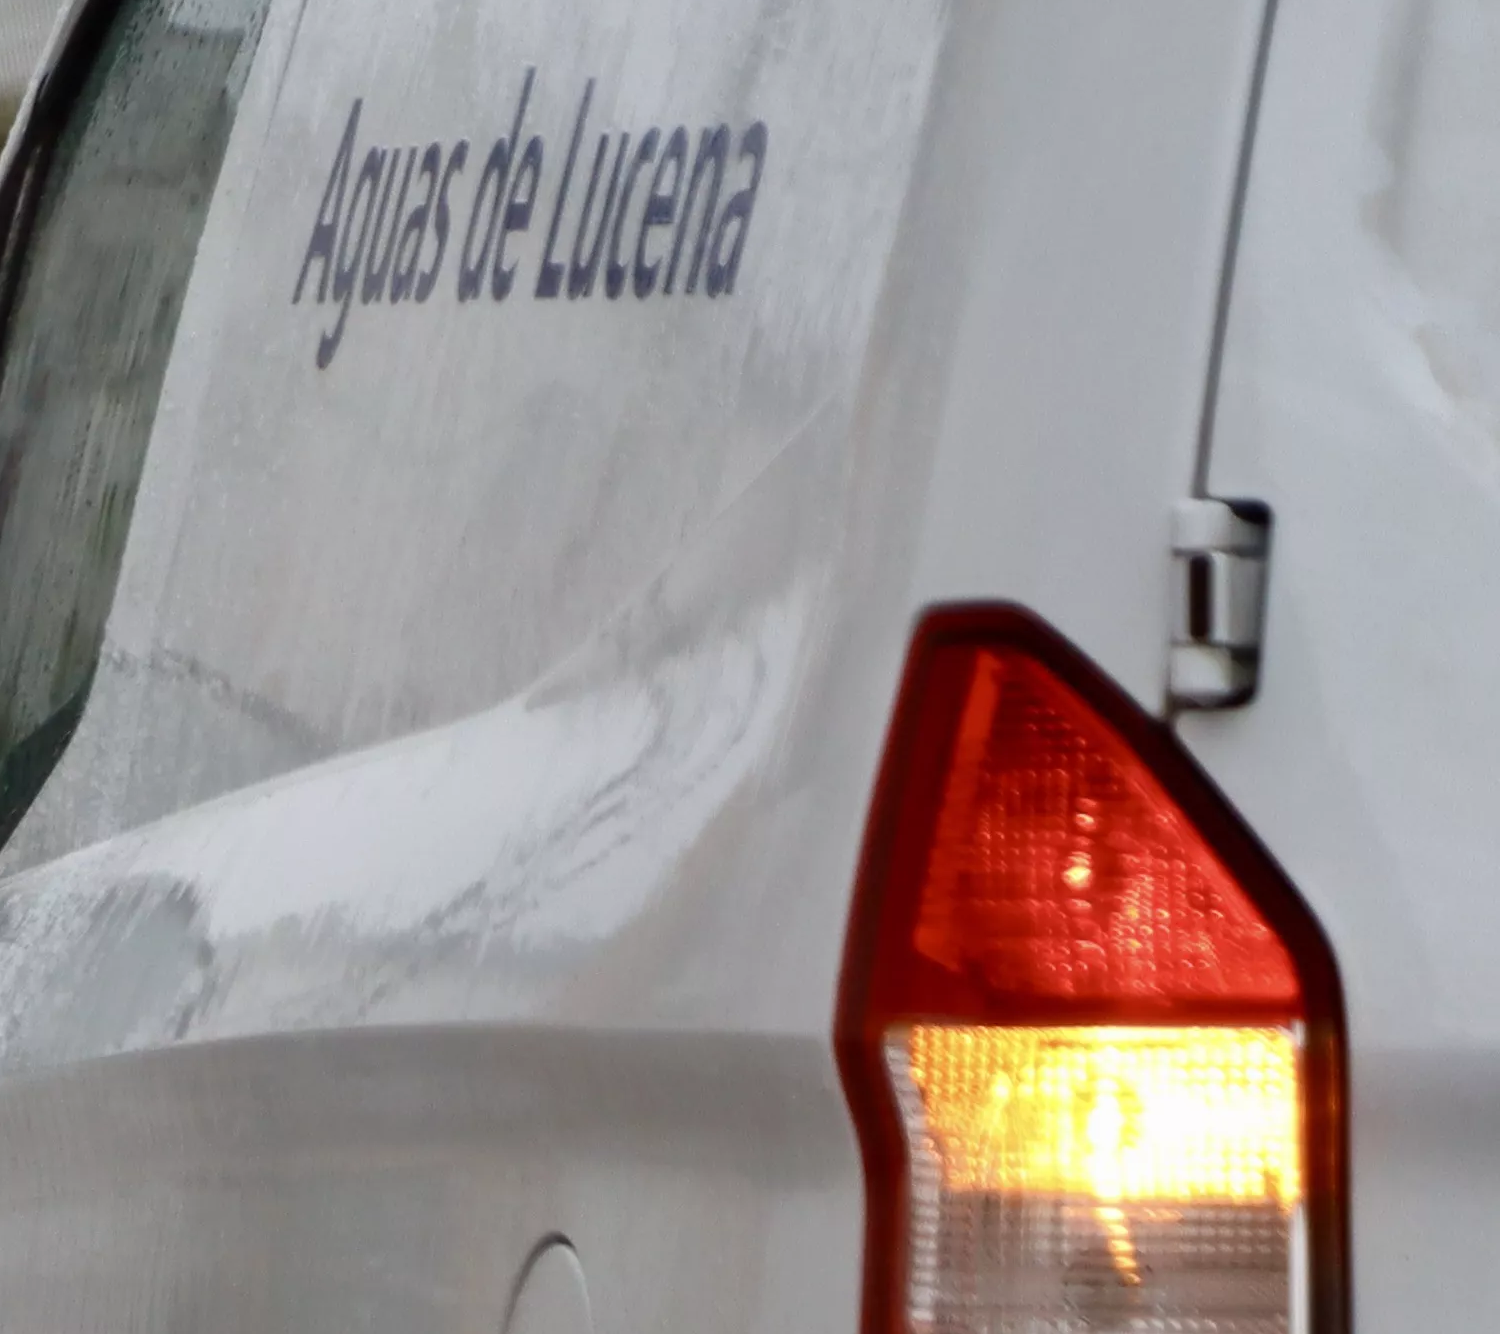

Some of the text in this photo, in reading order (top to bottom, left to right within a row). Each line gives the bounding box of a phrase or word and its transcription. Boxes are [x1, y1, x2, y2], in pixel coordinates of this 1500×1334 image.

[291, 65, 769, 371] Aguas de Lucena
